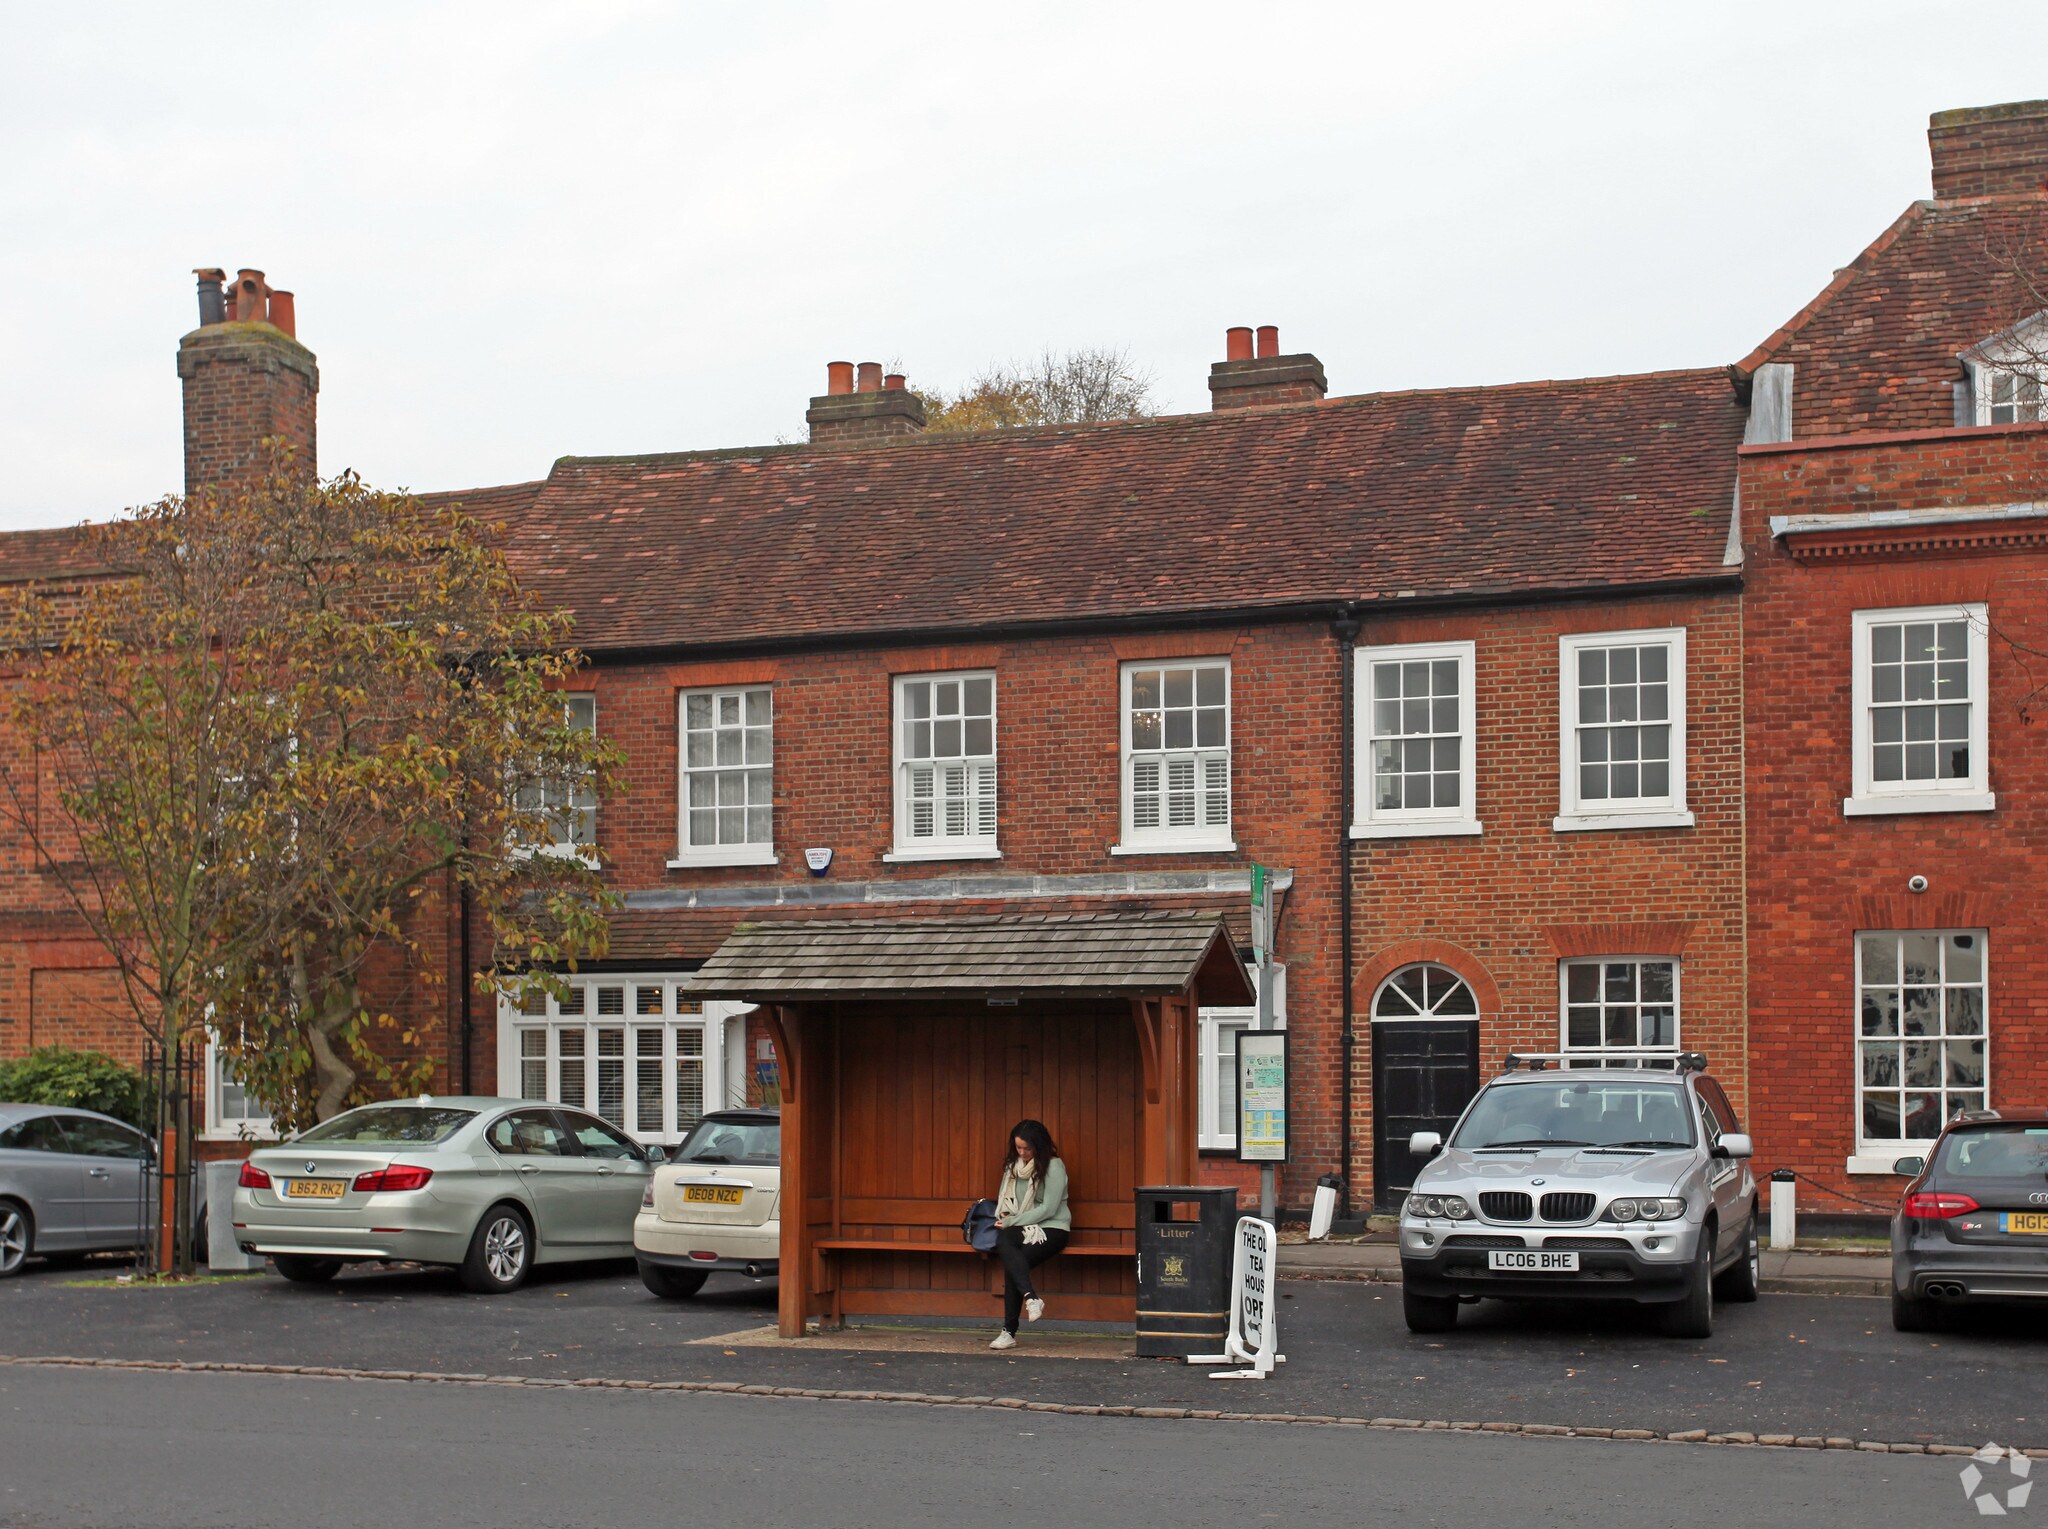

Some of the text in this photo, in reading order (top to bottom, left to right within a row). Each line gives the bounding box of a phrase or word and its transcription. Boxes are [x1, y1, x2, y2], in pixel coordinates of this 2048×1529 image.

[290, 1182, 342, 1195] LB62 RKZ
[688, 1188, 738, 1202] OE08 NZC
[1161, 1229, 1190, 1238] Litter
[1243, 1231, 1267, 1253] THE OL
[1249, 1254, 1264, 1273] TEA
[1496, 1253, 1572, 1268] LC06 BHE
[1245, 1273, 1265, 1294] HOUS
[1244, 1296, 1264, 1320] OPE
